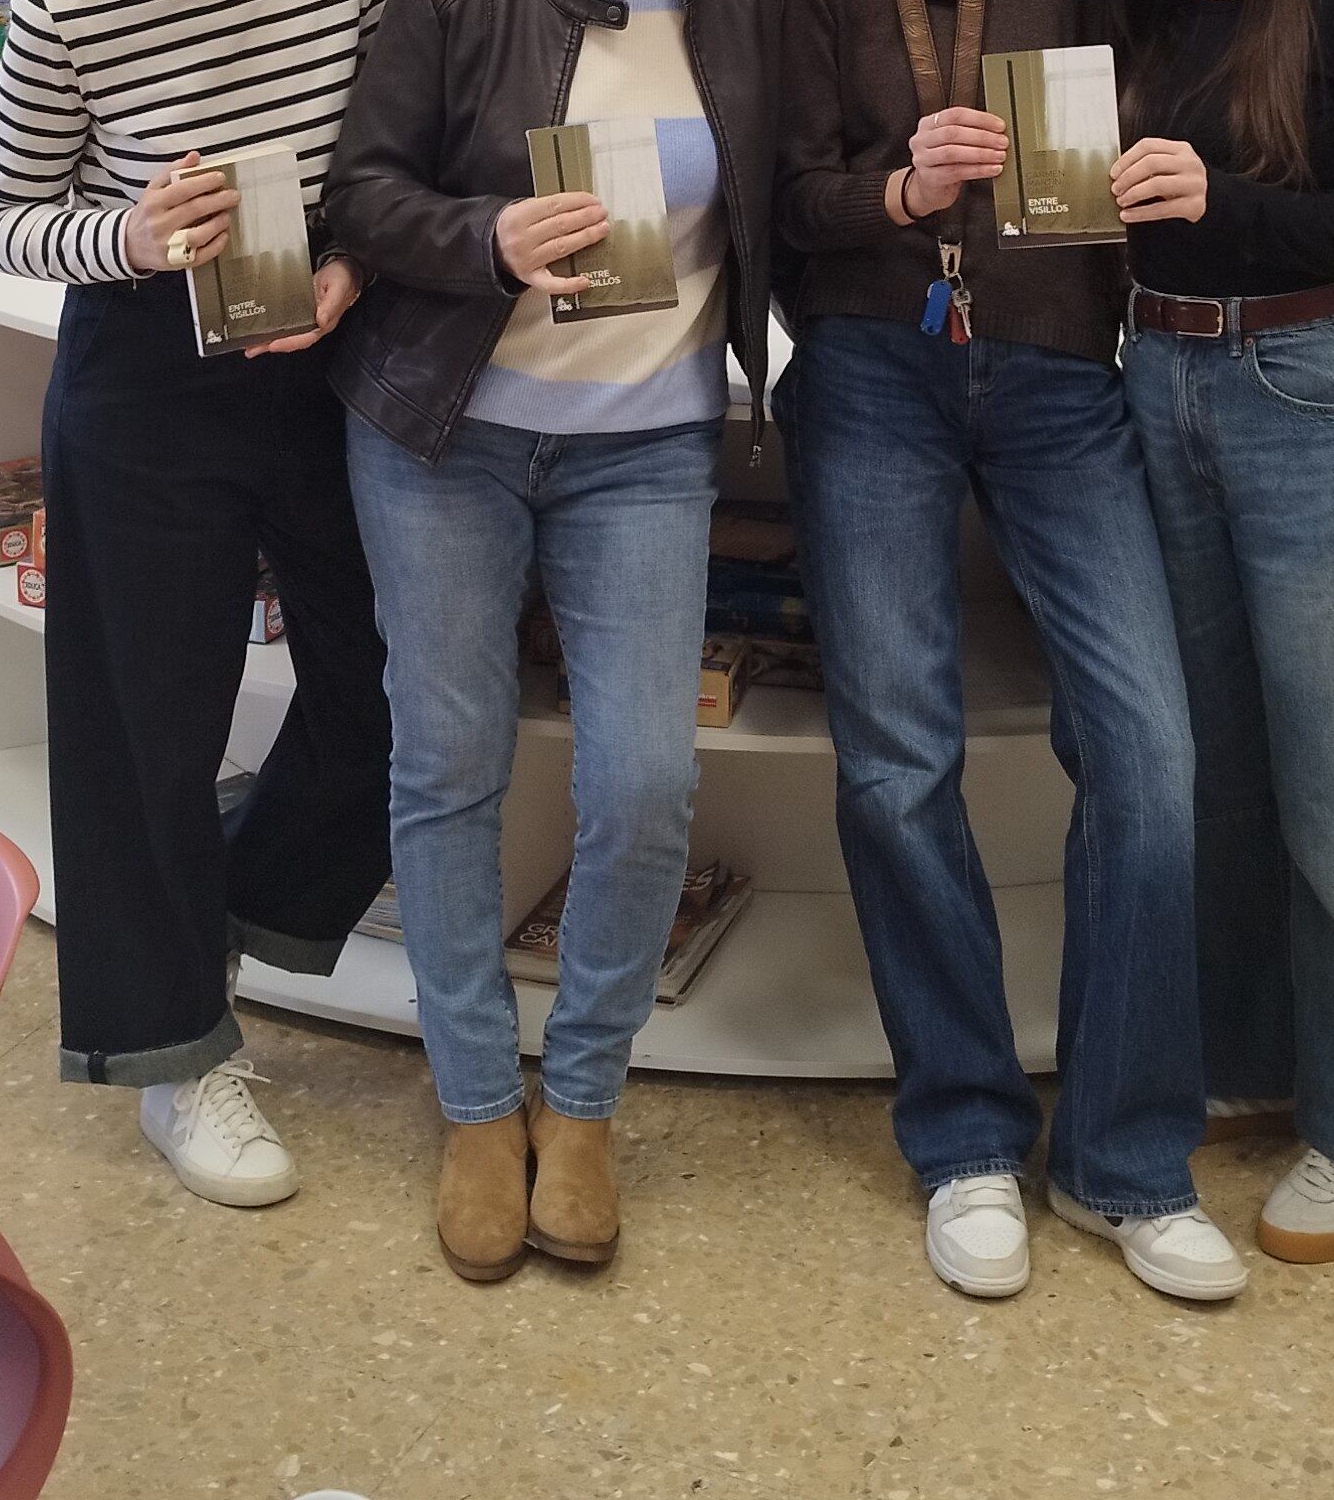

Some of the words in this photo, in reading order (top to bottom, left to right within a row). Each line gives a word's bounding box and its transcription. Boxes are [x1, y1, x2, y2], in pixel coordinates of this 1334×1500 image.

[1028, 197, 1059, 206] ENTRE
[1028, 204, 1069, 214] VISILLOS
[228, 300, 256, 313] ENTRE
[229, 306, 266, 320] VISILLOS
